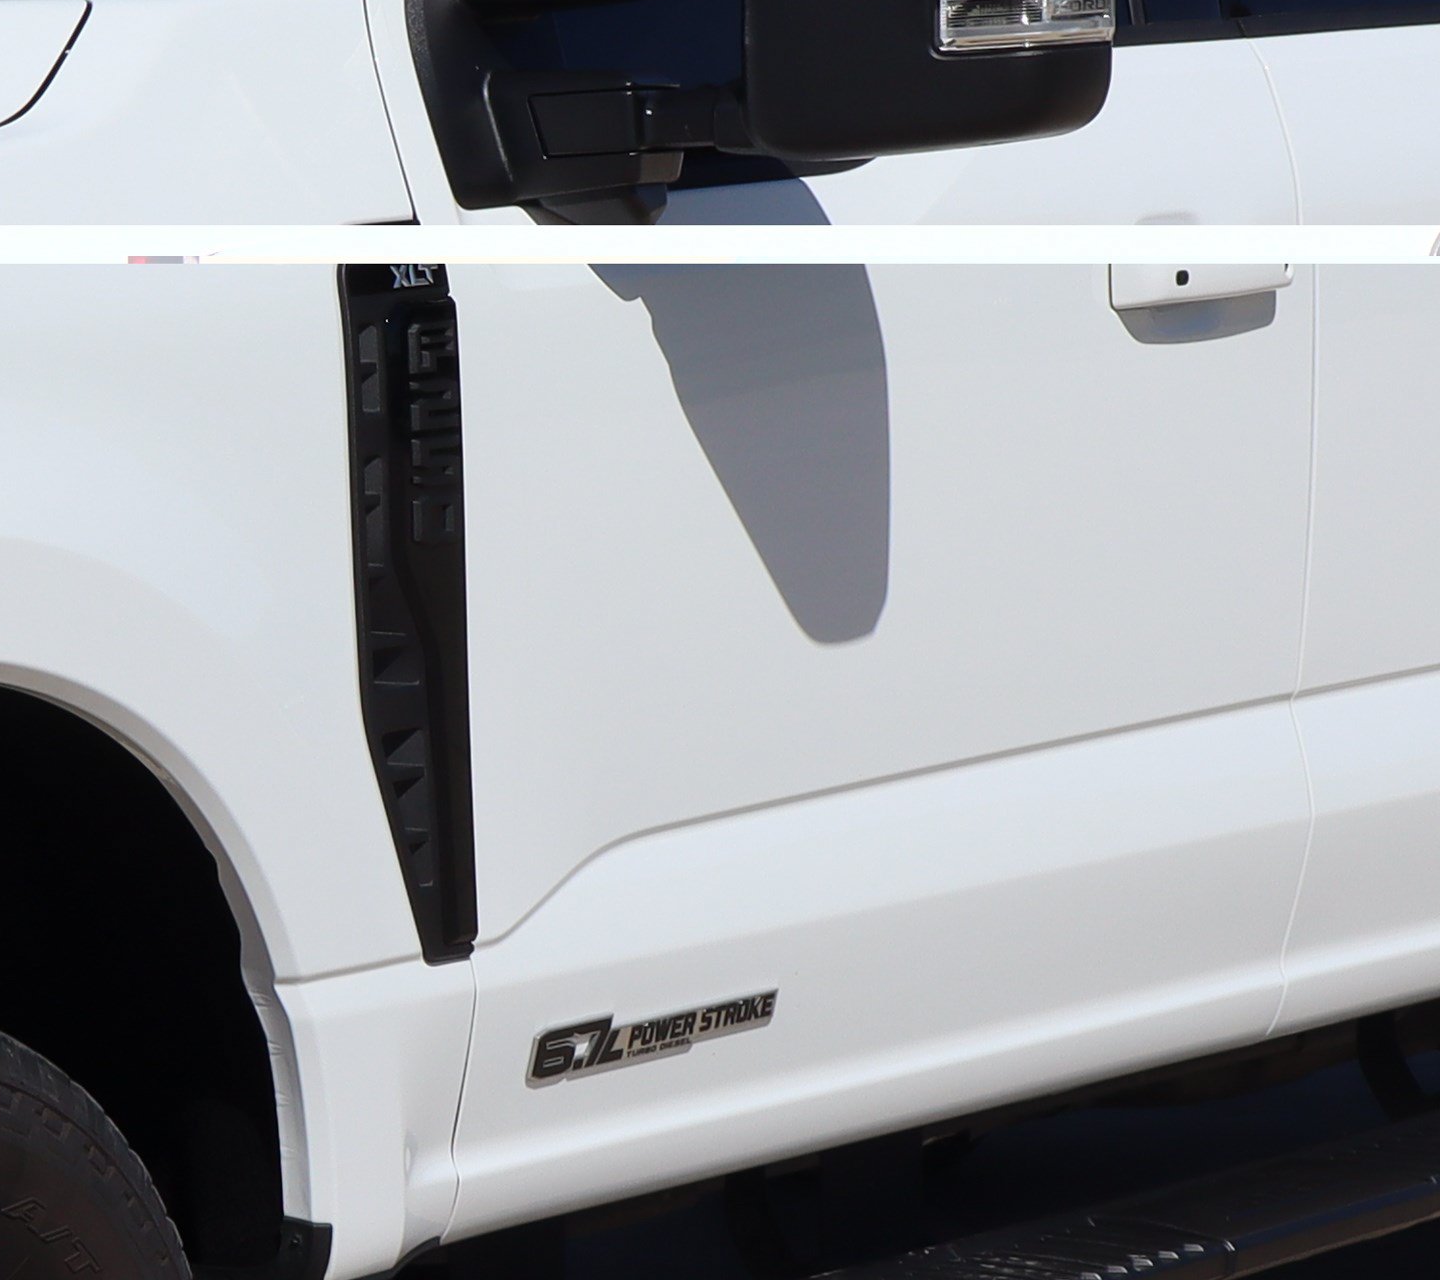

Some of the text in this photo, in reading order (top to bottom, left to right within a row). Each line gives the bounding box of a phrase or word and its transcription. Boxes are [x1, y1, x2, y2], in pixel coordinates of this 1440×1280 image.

[389, 263, 439, 289] XLT
[531, 993, 778, 1078] 6.7L POWER STROKE
[627, 1038, 691, 1058] TURBO DIESEL
